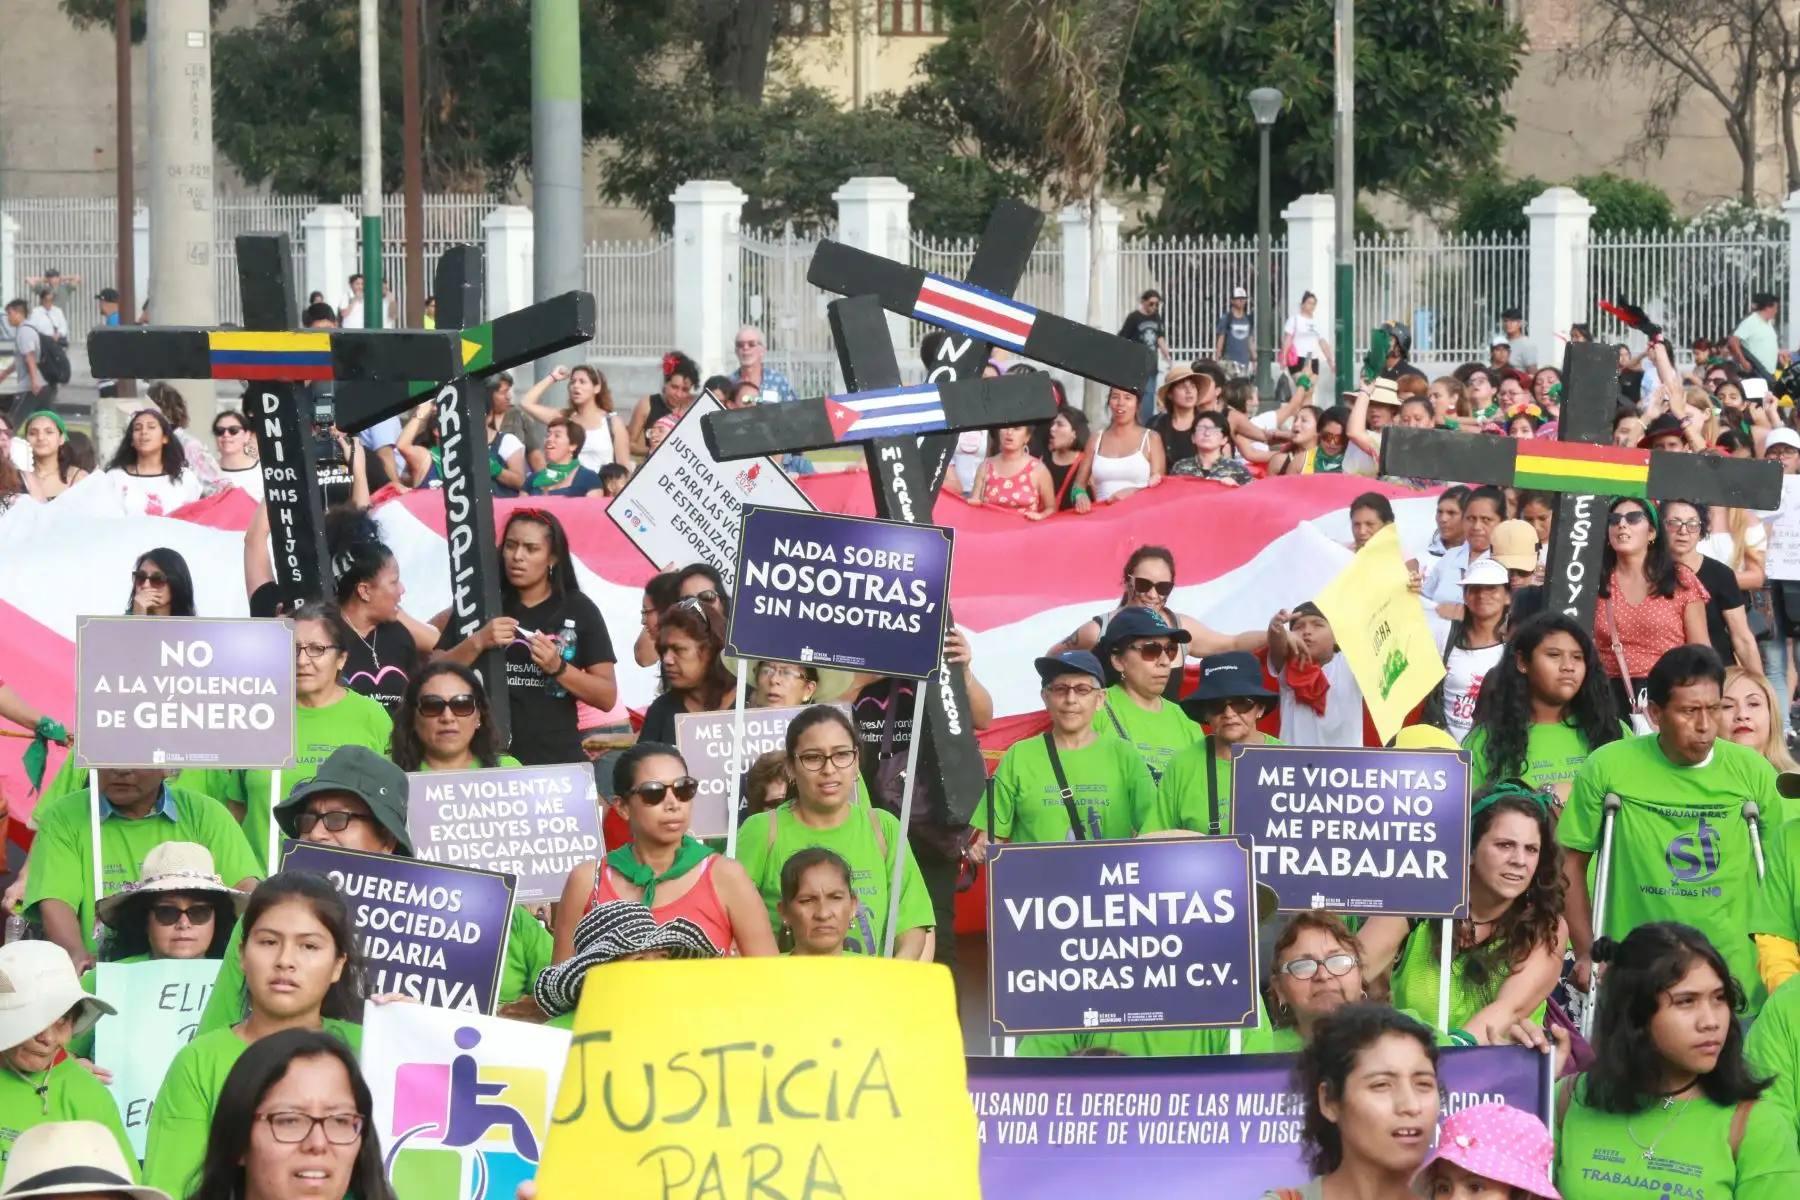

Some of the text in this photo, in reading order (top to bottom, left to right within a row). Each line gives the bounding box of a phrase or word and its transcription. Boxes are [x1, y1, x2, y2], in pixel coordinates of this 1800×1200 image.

[670, 436, 714, 486] JUSTICIA
[713, 480, 724, 492] Y
[881, 446, 902, 461] MI
[264, 466, 298, 482] POR
[658, 474, 676, 494] DE
[269, 487, 299, 503] MIS
[675, 466, 703, 500] PARA
[701, 496, 724, 521] LAS
[280, 507, 303, 583] HIJOS
[436, 384, 484, 688] RESPET
[1566, 494, 1595, 604] ESTOY
[670, 514, 736, 586] ESFORZADAS
[773, 537, 915, 573] NADA SOBRE
[745, 559, 936, 613] NOSOTRAS,
[753, 595, 921, 633] SIN NOSOTRAS
[160, 640, 214, 668] NO
[94, 675, 278, 696] A LA VIOLENCIA
[96, 695, 275, 730] DE GÉNERO
[695, 724, 722, 740] ME
[425, 776, 573, 802] ME VIOLENTAS
[1258, 766, 1447, 791] ME VIOLENTAS
[438, 798, 565, 821] CUANDO ME
[1270, 792, 1433, 816] CUANDO NO
[430, 816, 580, 842] EXCLUYES POR
[1266, 818, 1437, 843] ME PERMITES
[416, 835, 598, 862] MI DISCAPACIDAD
[488, 860, 526, 877] SER
[1100, 862, 1140, 886] ME
[1254, 845, 1449, 880] TRABAJAR
[1639, 885, 1698, 897] VIOLENTADAS
[1004, 889, 1235, 931] VIOLENTAS
[355, 905, 481, 944] SOCIEDAD
[1060, 934, 1183, 962] CUANDO
[1007, 962, 1239, 993] IGNORAS MI C.V.
[159, 982, 215, 1012] ELI
[1056, 1093, 1074, 1117] EL
[1081, 1093, 1162, 1117] DERECHO
[1168, 1093, 1191, 1117] DE
[1197, 1093, 1229, 1117] LAS
[998, 1121, 1038, 1144] VIDA
[1048, 1121, 1099, 1144] LIBRE
[1107, 1121, 1129, 1144] DE
[1138, 1121, 1230, 1144] VIOLENCIA
[1240, 1121, 1251, 1144] Y
[638, 1143, 848, 1200] PARA
